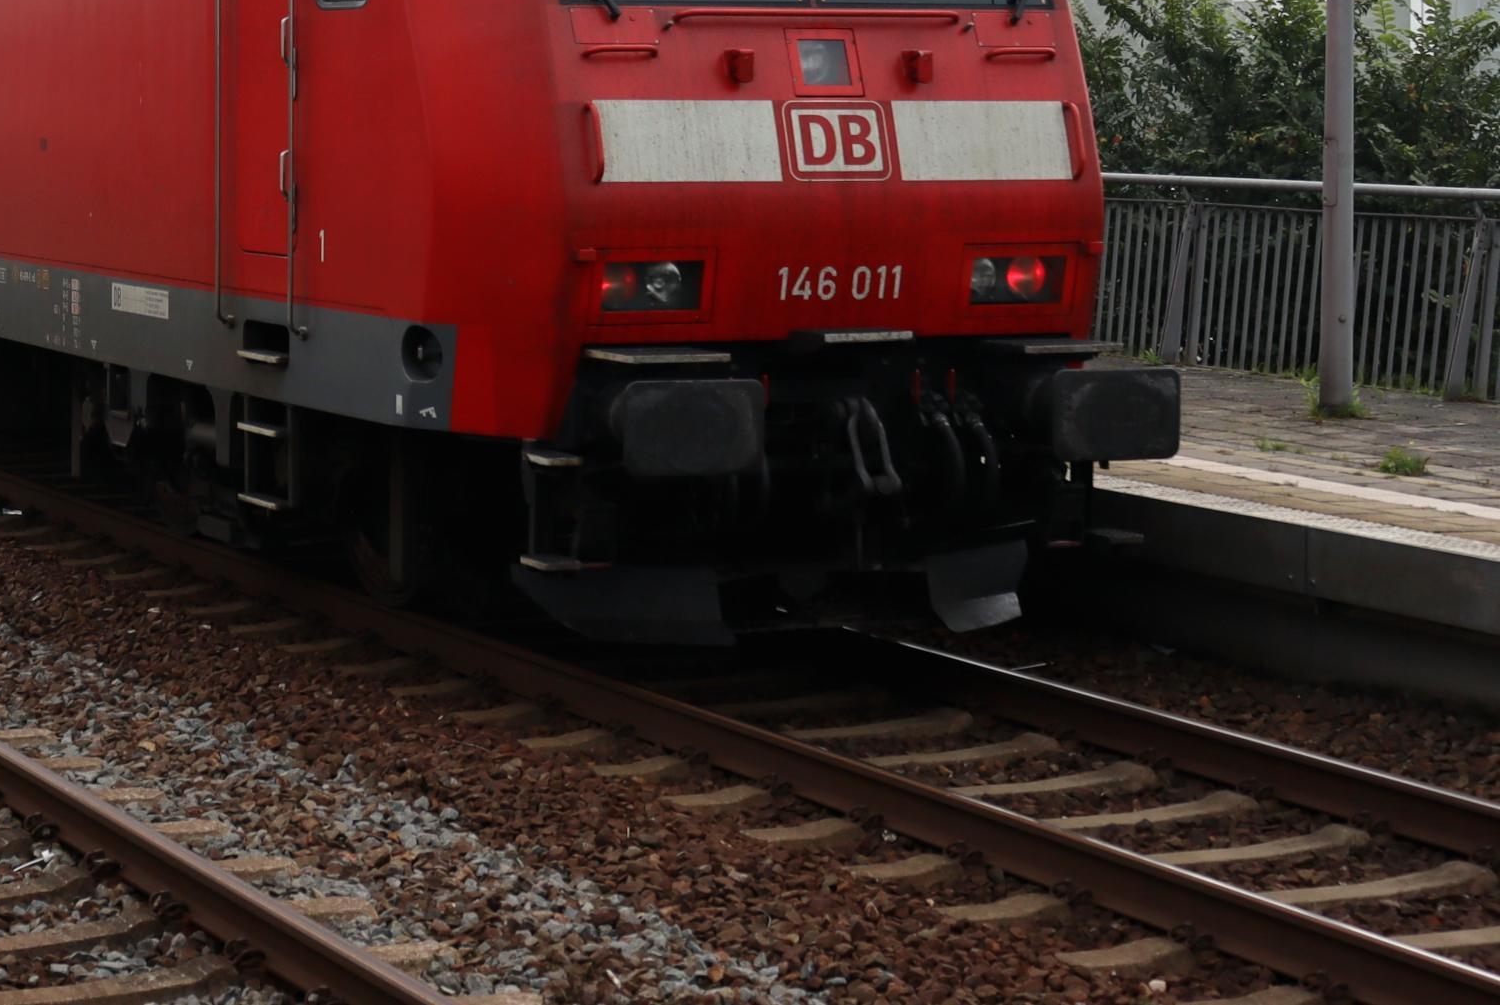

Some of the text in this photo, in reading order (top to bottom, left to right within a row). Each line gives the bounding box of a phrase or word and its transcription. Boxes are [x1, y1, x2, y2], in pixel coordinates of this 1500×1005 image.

[798, 113, 878, 167] DB
[319, 229, 325, 262] 1
[777, 264, 903, 302] 146 011
